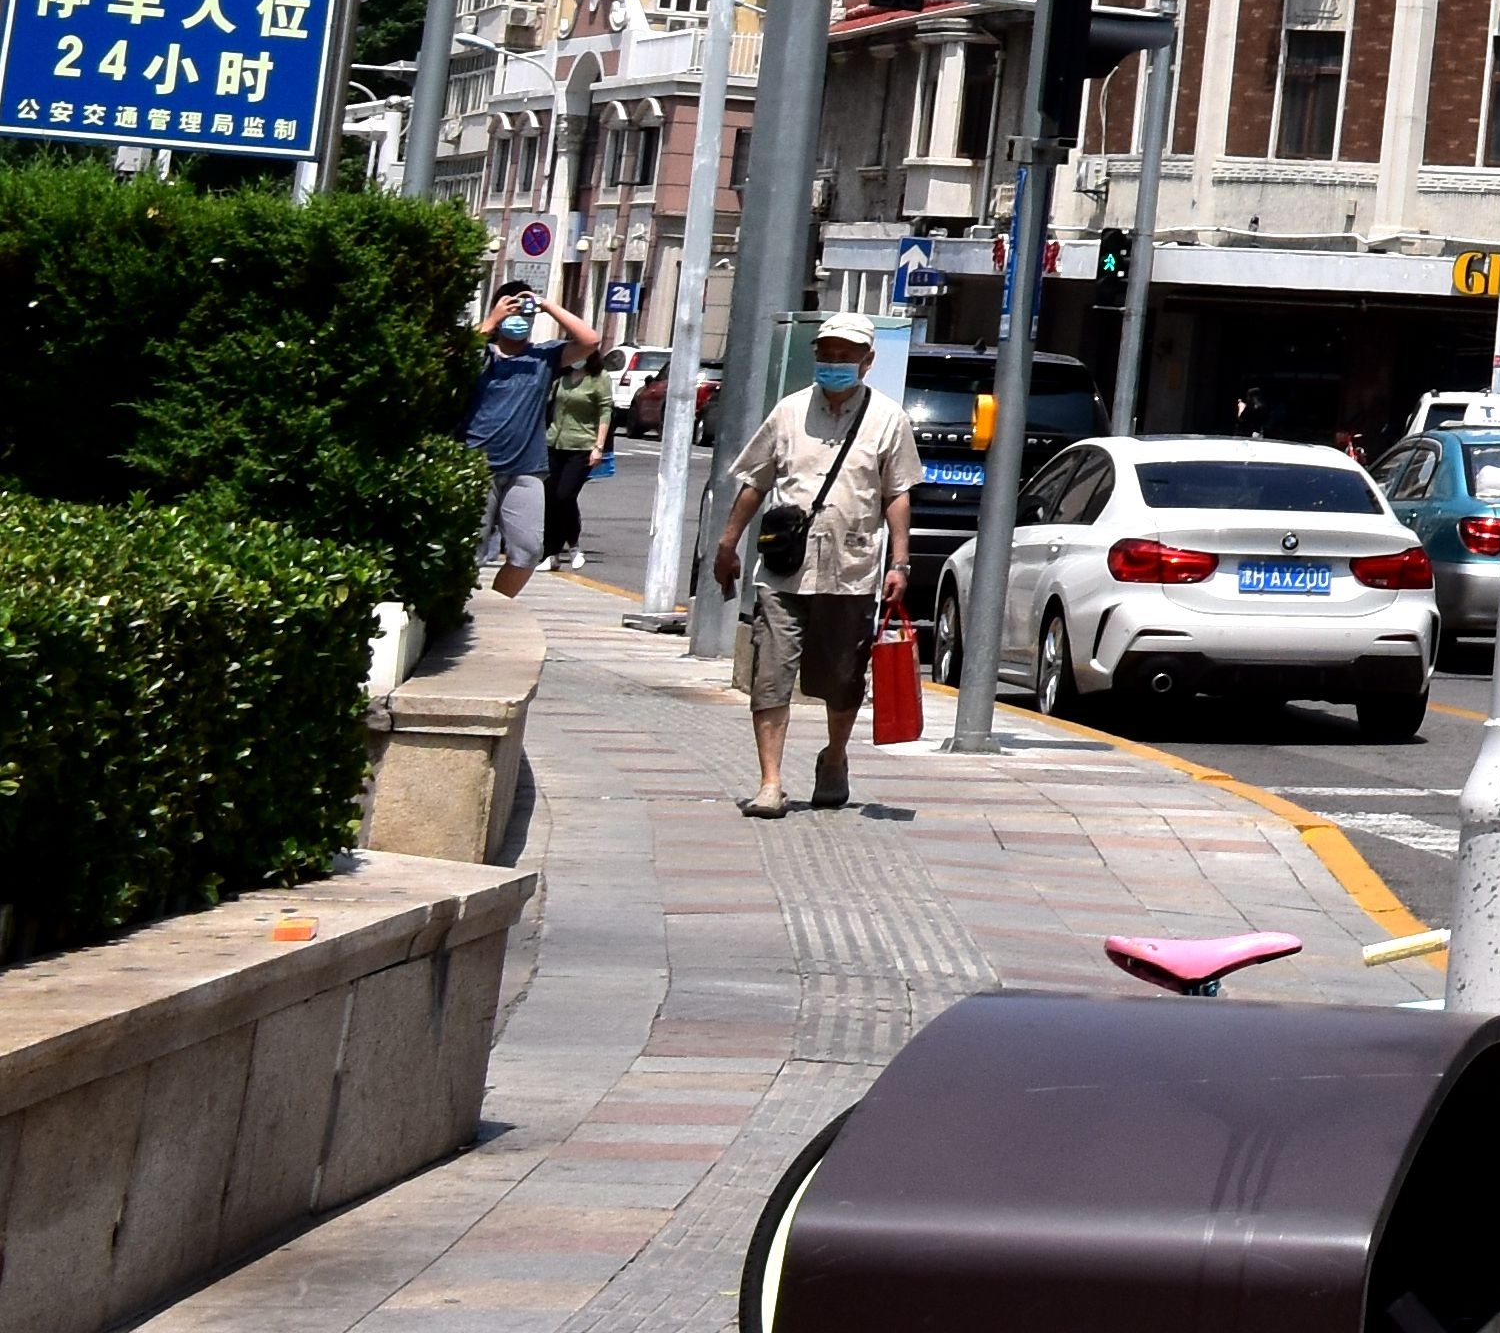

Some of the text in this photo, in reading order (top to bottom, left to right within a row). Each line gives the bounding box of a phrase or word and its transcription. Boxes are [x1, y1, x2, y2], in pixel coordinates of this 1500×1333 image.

[53, 35, 274, 103] 24小时
[17, 98, 297, 142] 公安交通管理局监制
